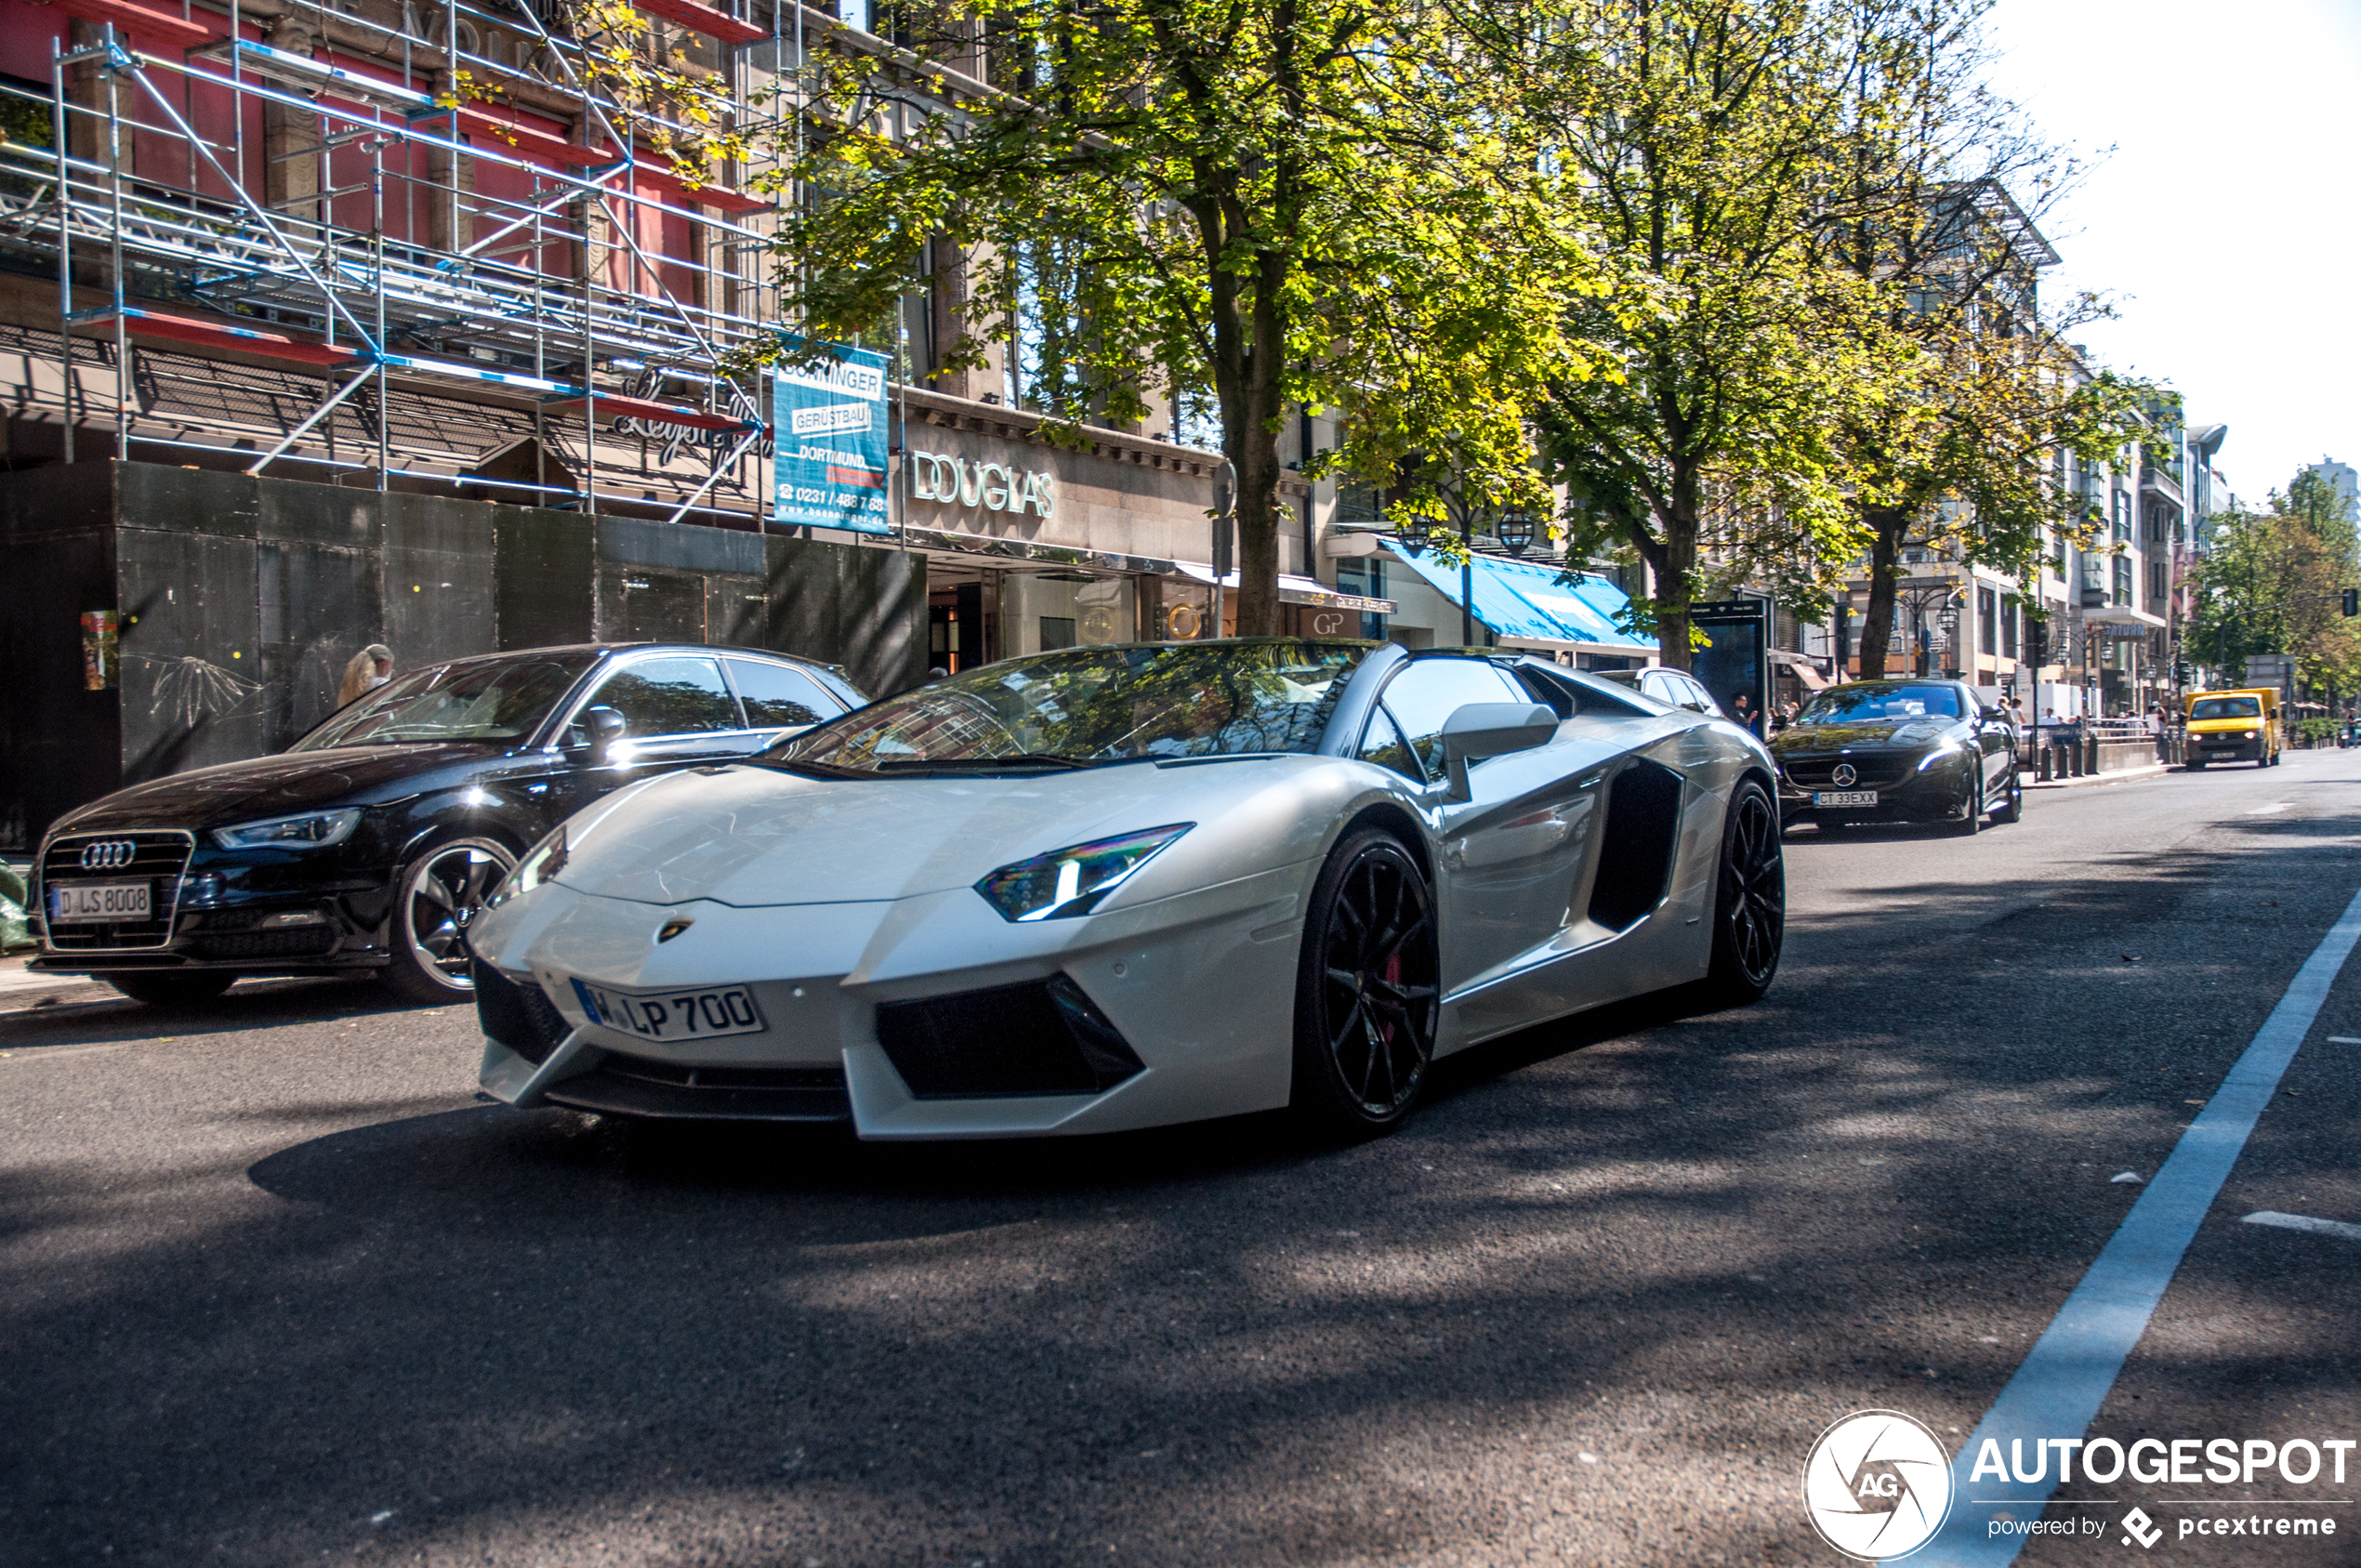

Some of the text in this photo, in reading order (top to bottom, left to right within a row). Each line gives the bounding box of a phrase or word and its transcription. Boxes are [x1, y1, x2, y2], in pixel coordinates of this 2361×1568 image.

[797, 408, 865, 428] GERÜSTBAU
[914, 451, 1054, 518] DOUGLAS
[796, 488, 825, 504] 0231
[1313, 613, 1344, 635] GP
[1820, 792, 1875, 804] CT 33EXX
[61, 888, 148, 914] D LS 8008
[621, 998, 669, 1036] LP
[672, 991, 756, 1033] 700
